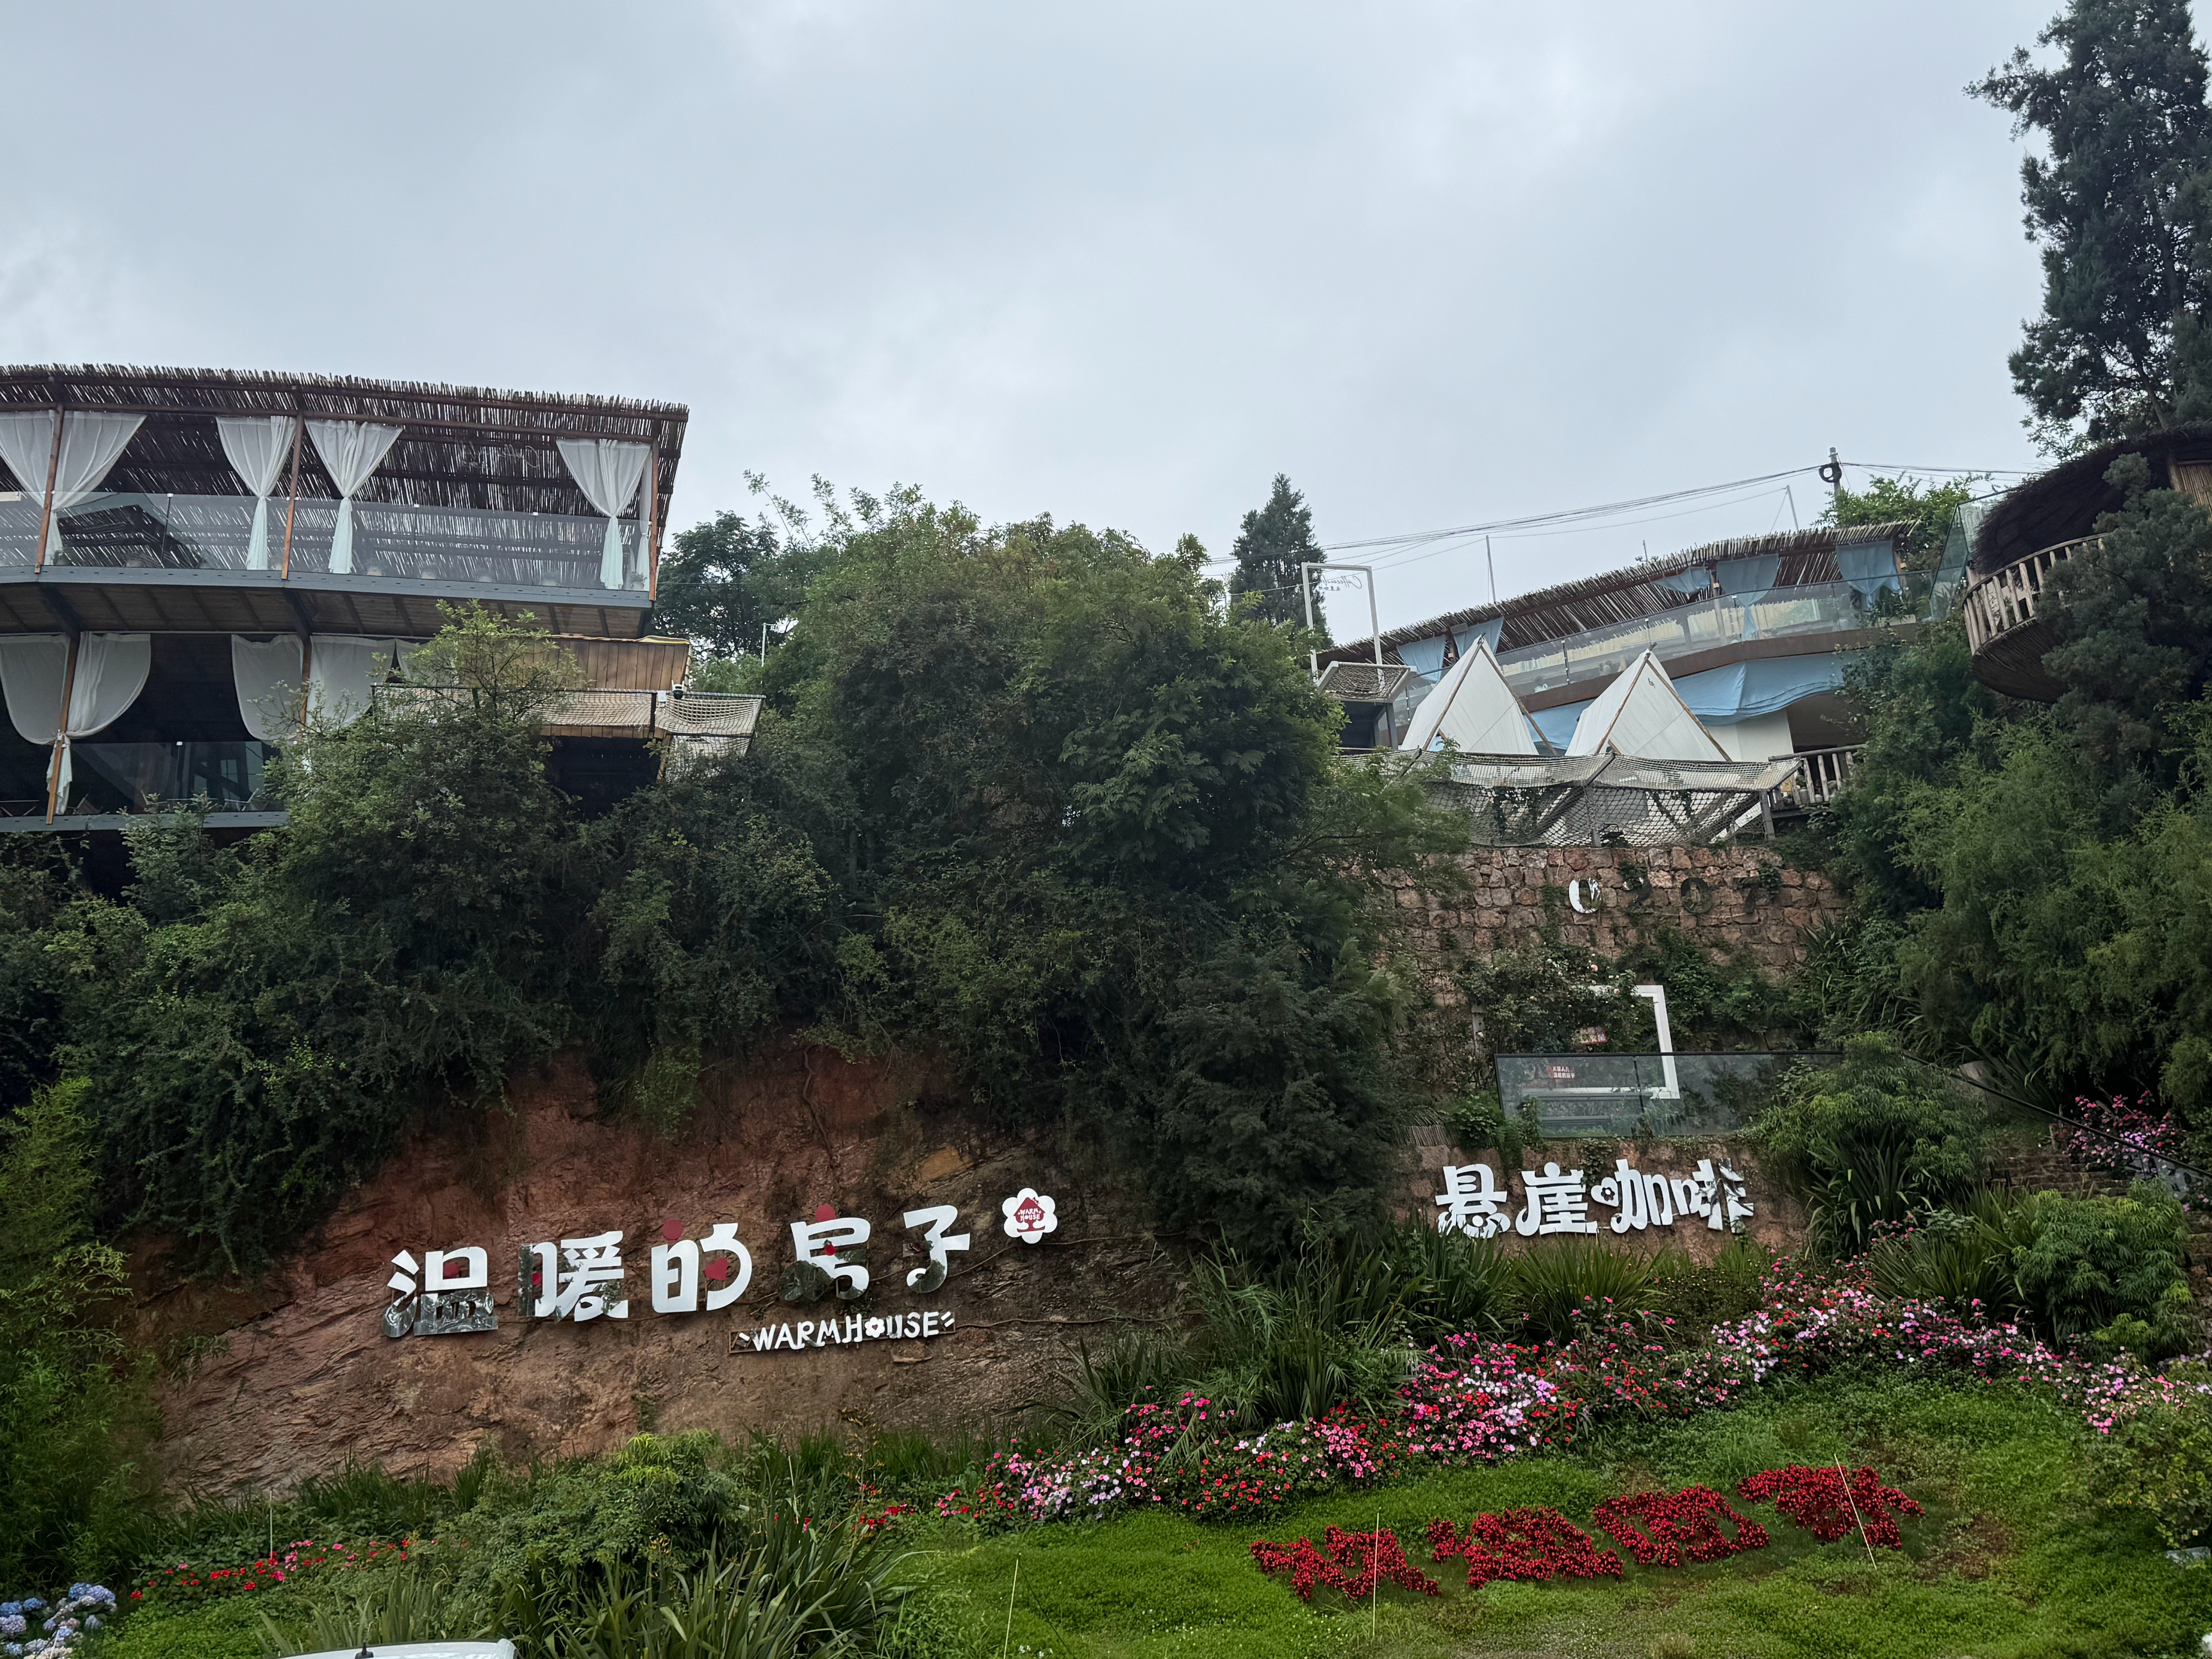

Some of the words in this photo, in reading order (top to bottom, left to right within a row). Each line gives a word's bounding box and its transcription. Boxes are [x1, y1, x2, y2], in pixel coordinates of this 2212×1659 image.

[1435, 1158, 1754, 1239] 悬崖咖啡
[382, 1204, 970, 1338] 温暖的房子
